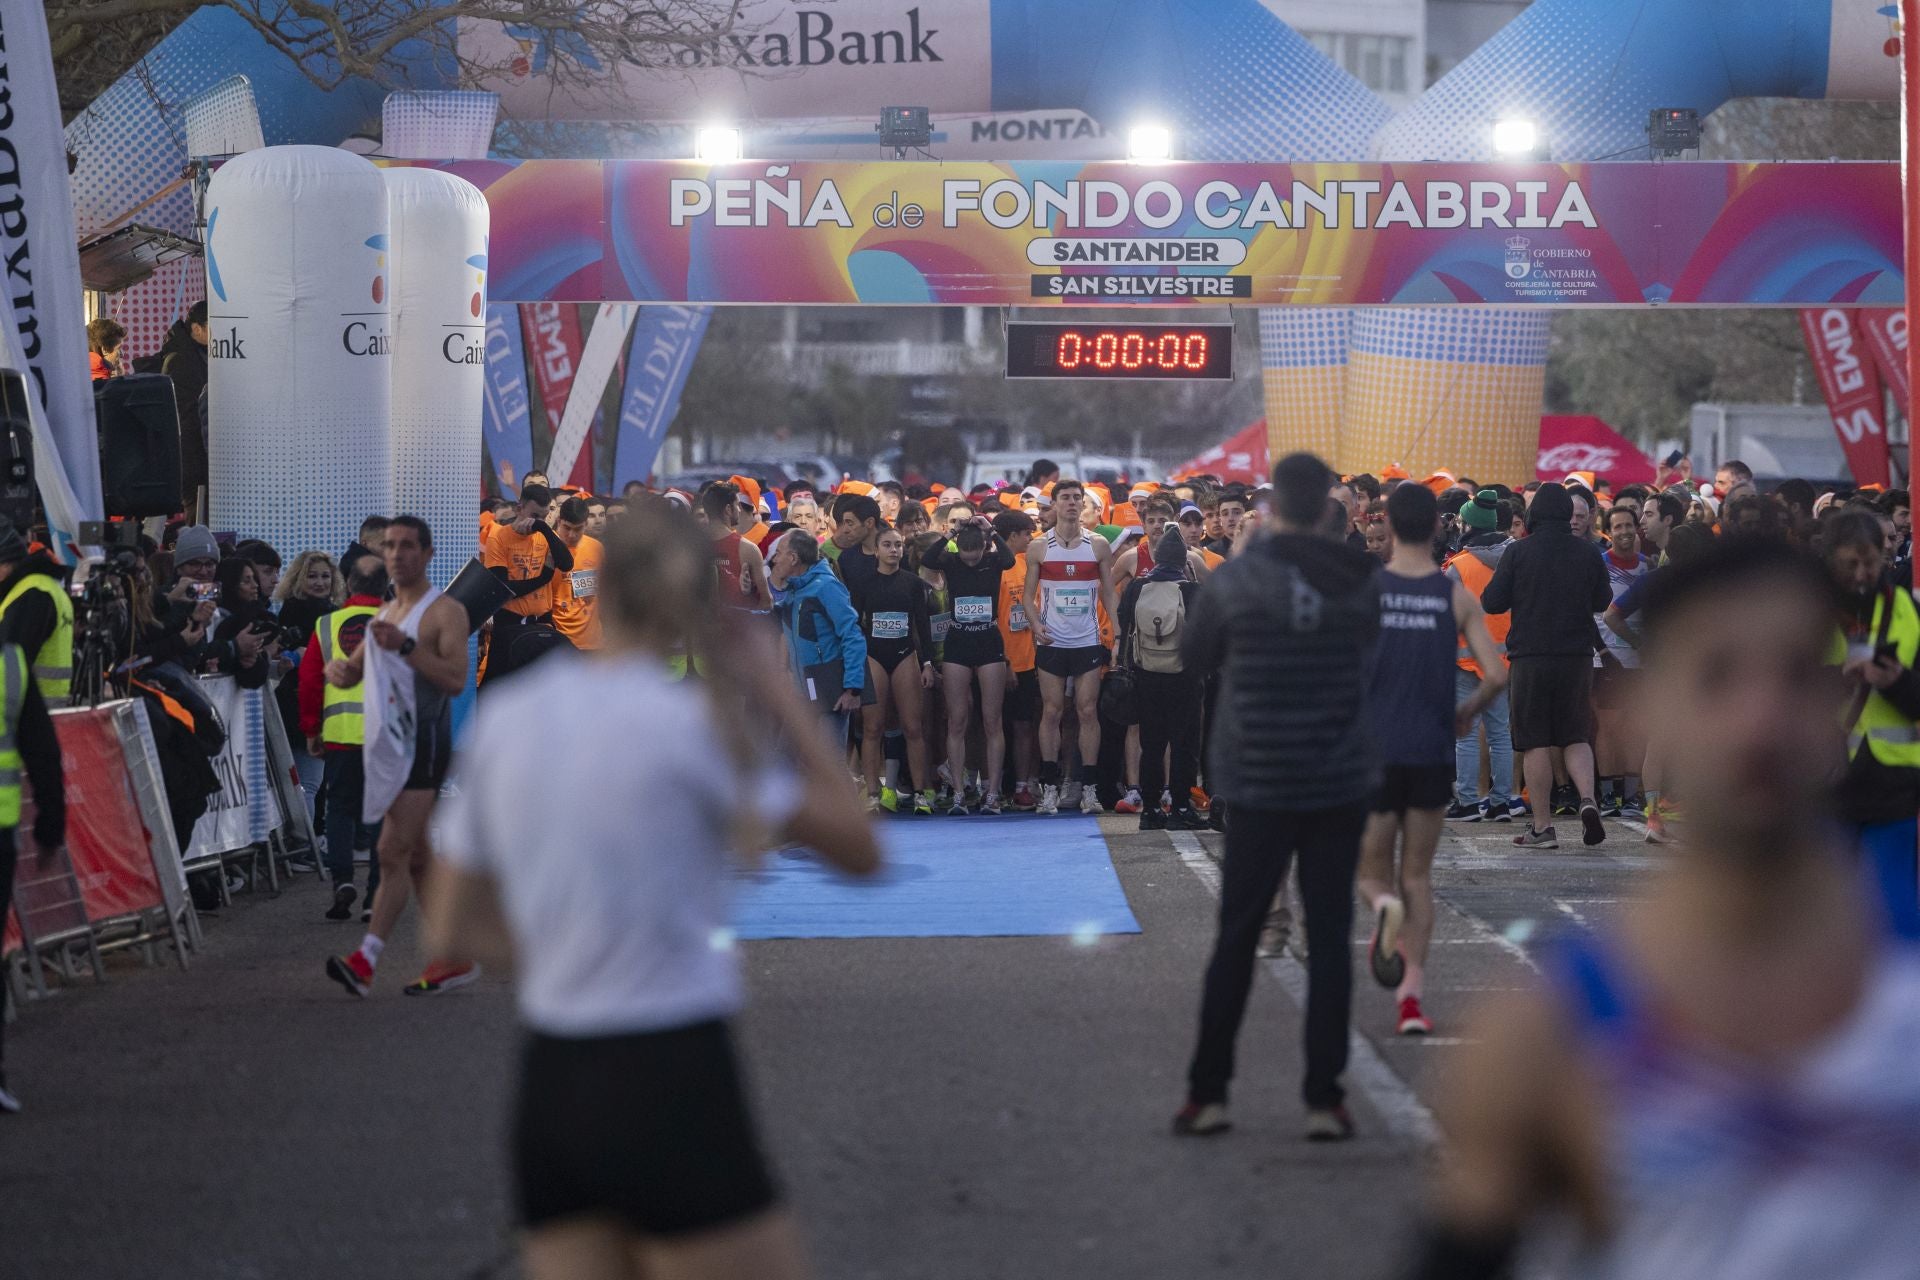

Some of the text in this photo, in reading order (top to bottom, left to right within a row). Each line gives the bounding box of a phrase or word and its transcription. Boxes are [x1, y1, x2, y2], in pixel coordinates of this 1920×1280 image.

[971, 118, 1107, 143] MONTA
[670, 165, 1599, 229] PEÑA de FONDO CANTABRIA
[1053, 241, 1219, 262] SANTANDER
[1533, 249, 1591, 258] GOBIERNO
[1533, 260, 1545, 268] de
[1533, 269, 1597, 279] CANTABRIA
[1049, 276, 1234, 295] SAN SILVESTRE
[208, 326, 247, 359] ank
[1058, 333, 1208, 369] 0:00:00
[1063, 596, 1078, 606] 14
[957, 605, 984, 615] 3928
[1012, 611, 1025, 622] 17
[874, 620, 902, 630] 3925
[936, 620, 949, 633] 60
